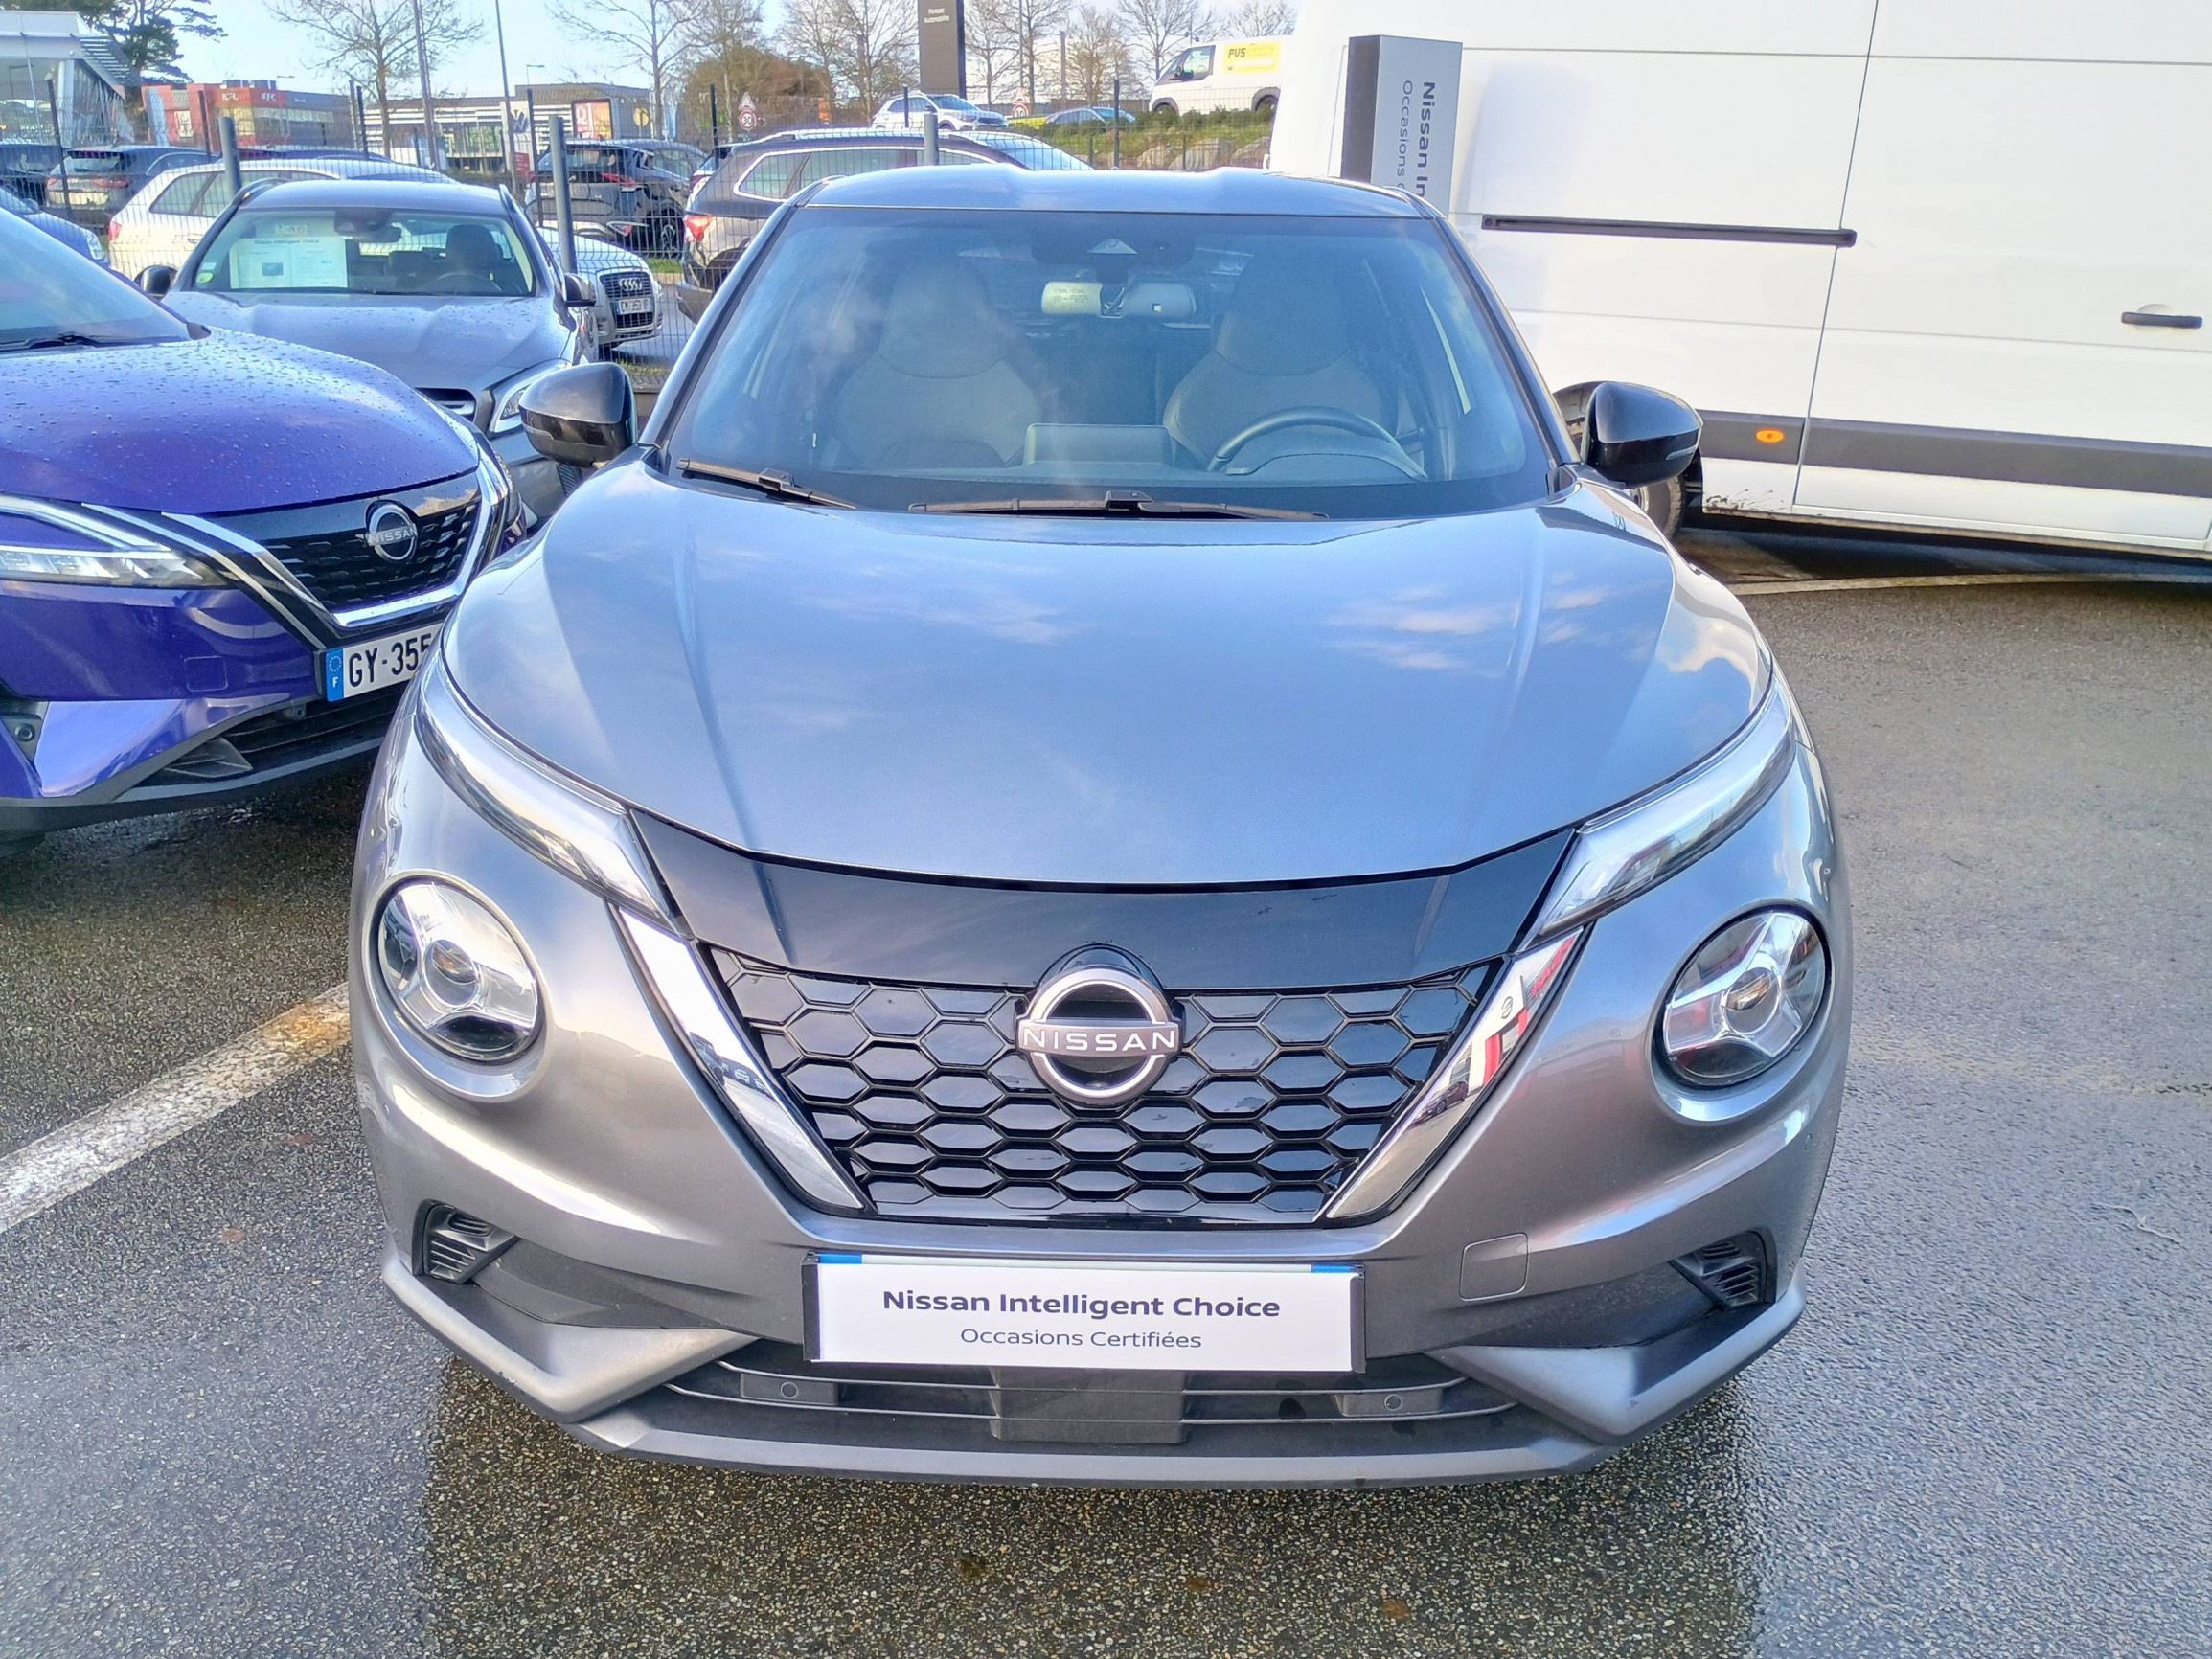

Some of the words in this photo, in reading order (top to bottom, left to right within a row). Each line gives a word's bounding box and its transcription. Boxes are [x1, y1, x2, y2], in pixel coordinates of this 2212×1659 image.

[1396, 80, 1414, 178] Occasions
[1417, 81, 1436, 169] Nissan
[370, 526, 418, 545] NISSAN
[331, 676, 339, 688] F
[1023, 1027, 1175, 1052] NISSAN
[883, 1289, 991, 1312] Nissan
[999, 1293, 1165, 1320] Intelligent
[1173, 1296, 1281, 1317] Choice
[960, 1328, 1083, 1347] Occasions
[1090, 1330, 1202, 1349] Certifiées
